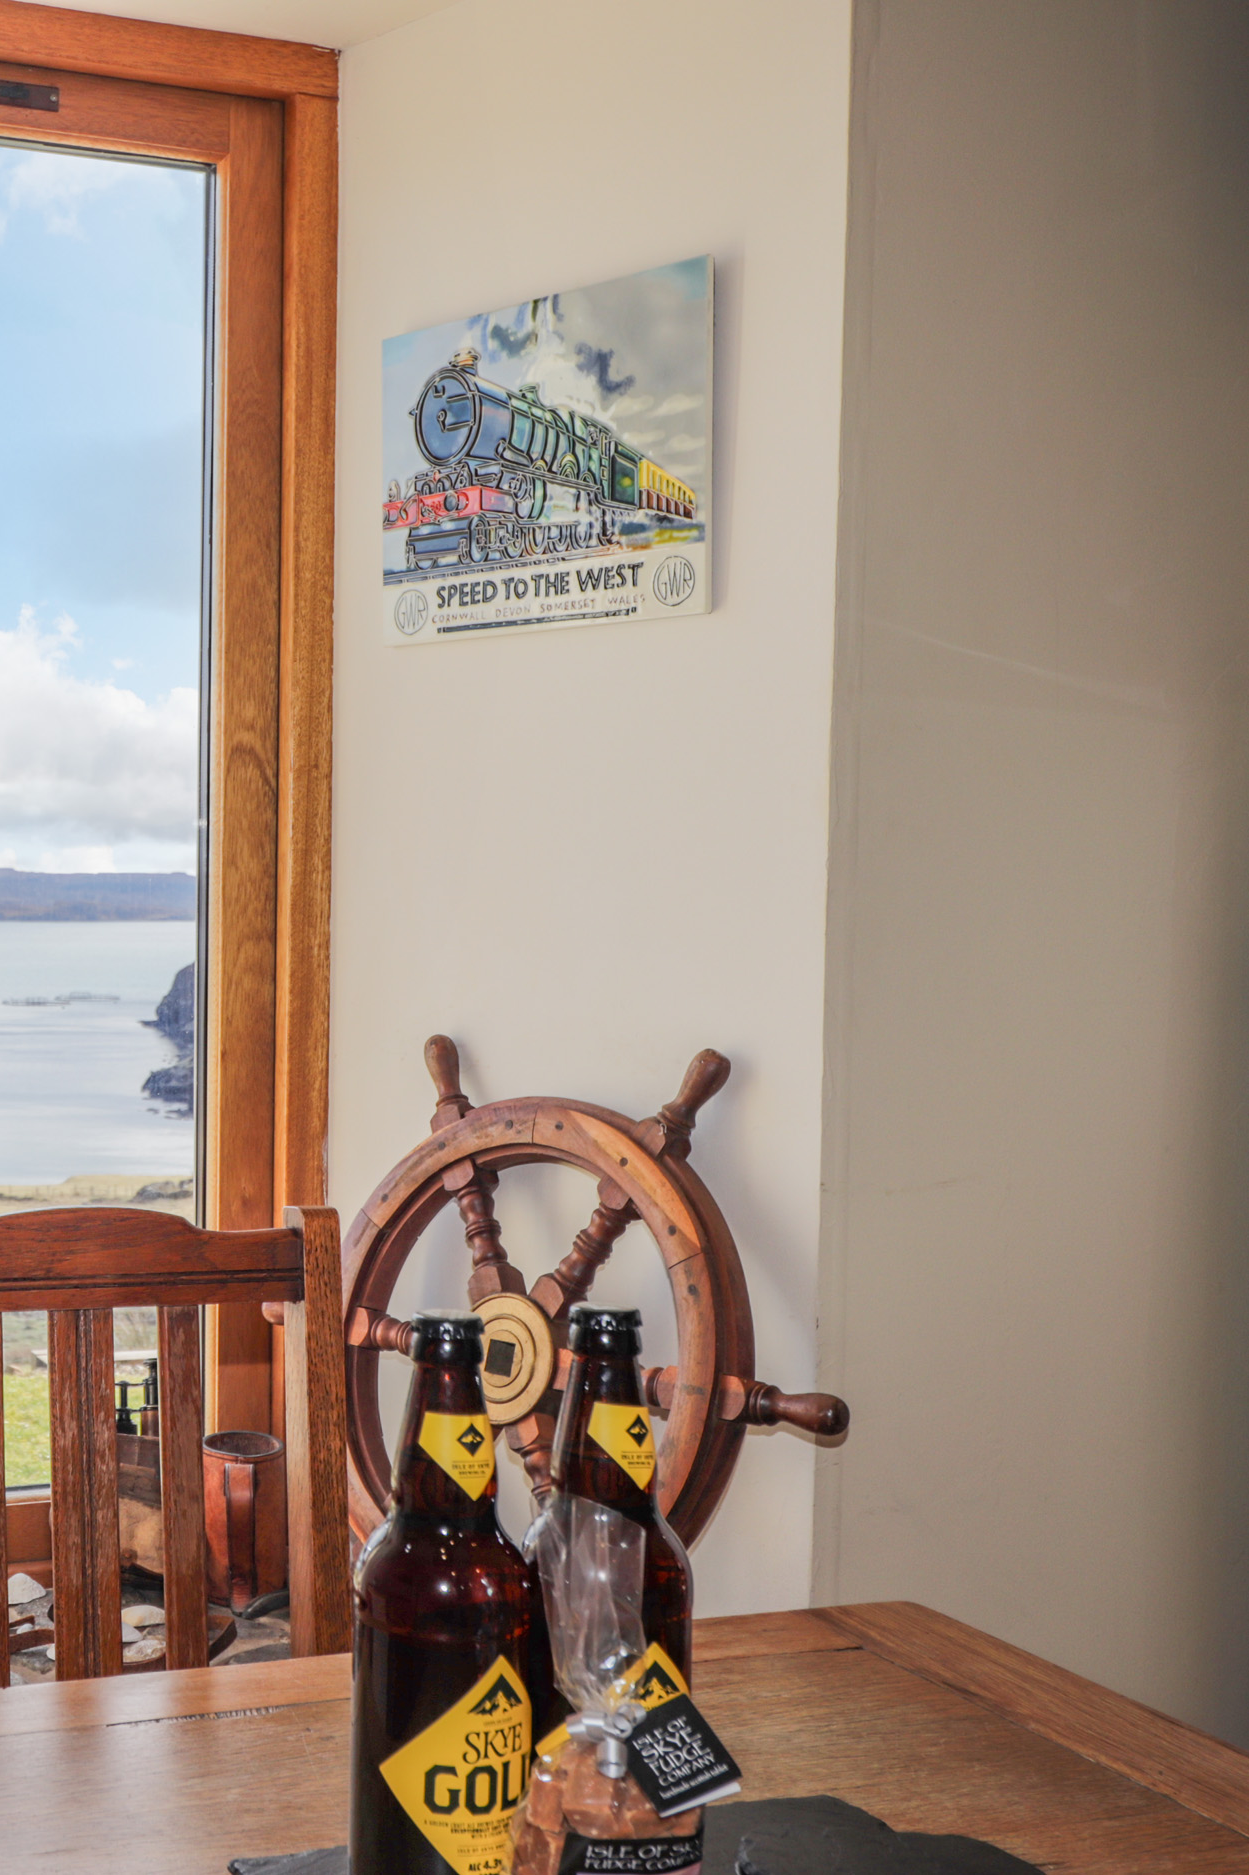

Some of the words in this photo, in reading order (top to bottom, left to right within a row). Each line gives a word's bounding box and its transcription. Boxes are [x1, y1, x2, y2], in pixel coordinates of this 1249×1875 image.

[436, 580, 498, 609] SPEED
[501, 577, 529, 600] TO
[531, 571, 570, 598] THE
[576, 561, 645, 592] WEST
[657, 560, 693, 600] GWR
[397, 592, 426, 631] GWR
[432, 610, 486, 624] CORNWALL
[495, 604, 531, 618] DEVON
[540, 599, 597, 614] SOMERSET
[607, 593, 646, 606] WALES
[462, 1722, 522, 1764] SKYE
[632, 1727, 669, 1751] ISLE
[666, 1716, 687, 1733] OF
[641, 1726, 702, 1763] SKYE
[648, 1740, 711, 1777] FUDGE
[658, 1753, 715, 1786] COMPANY
[585, 1858, 643, 1871] FUDGE
[586, 1844, 634, 1859] ISLE
[638, 1844, 668, 1859] OF
